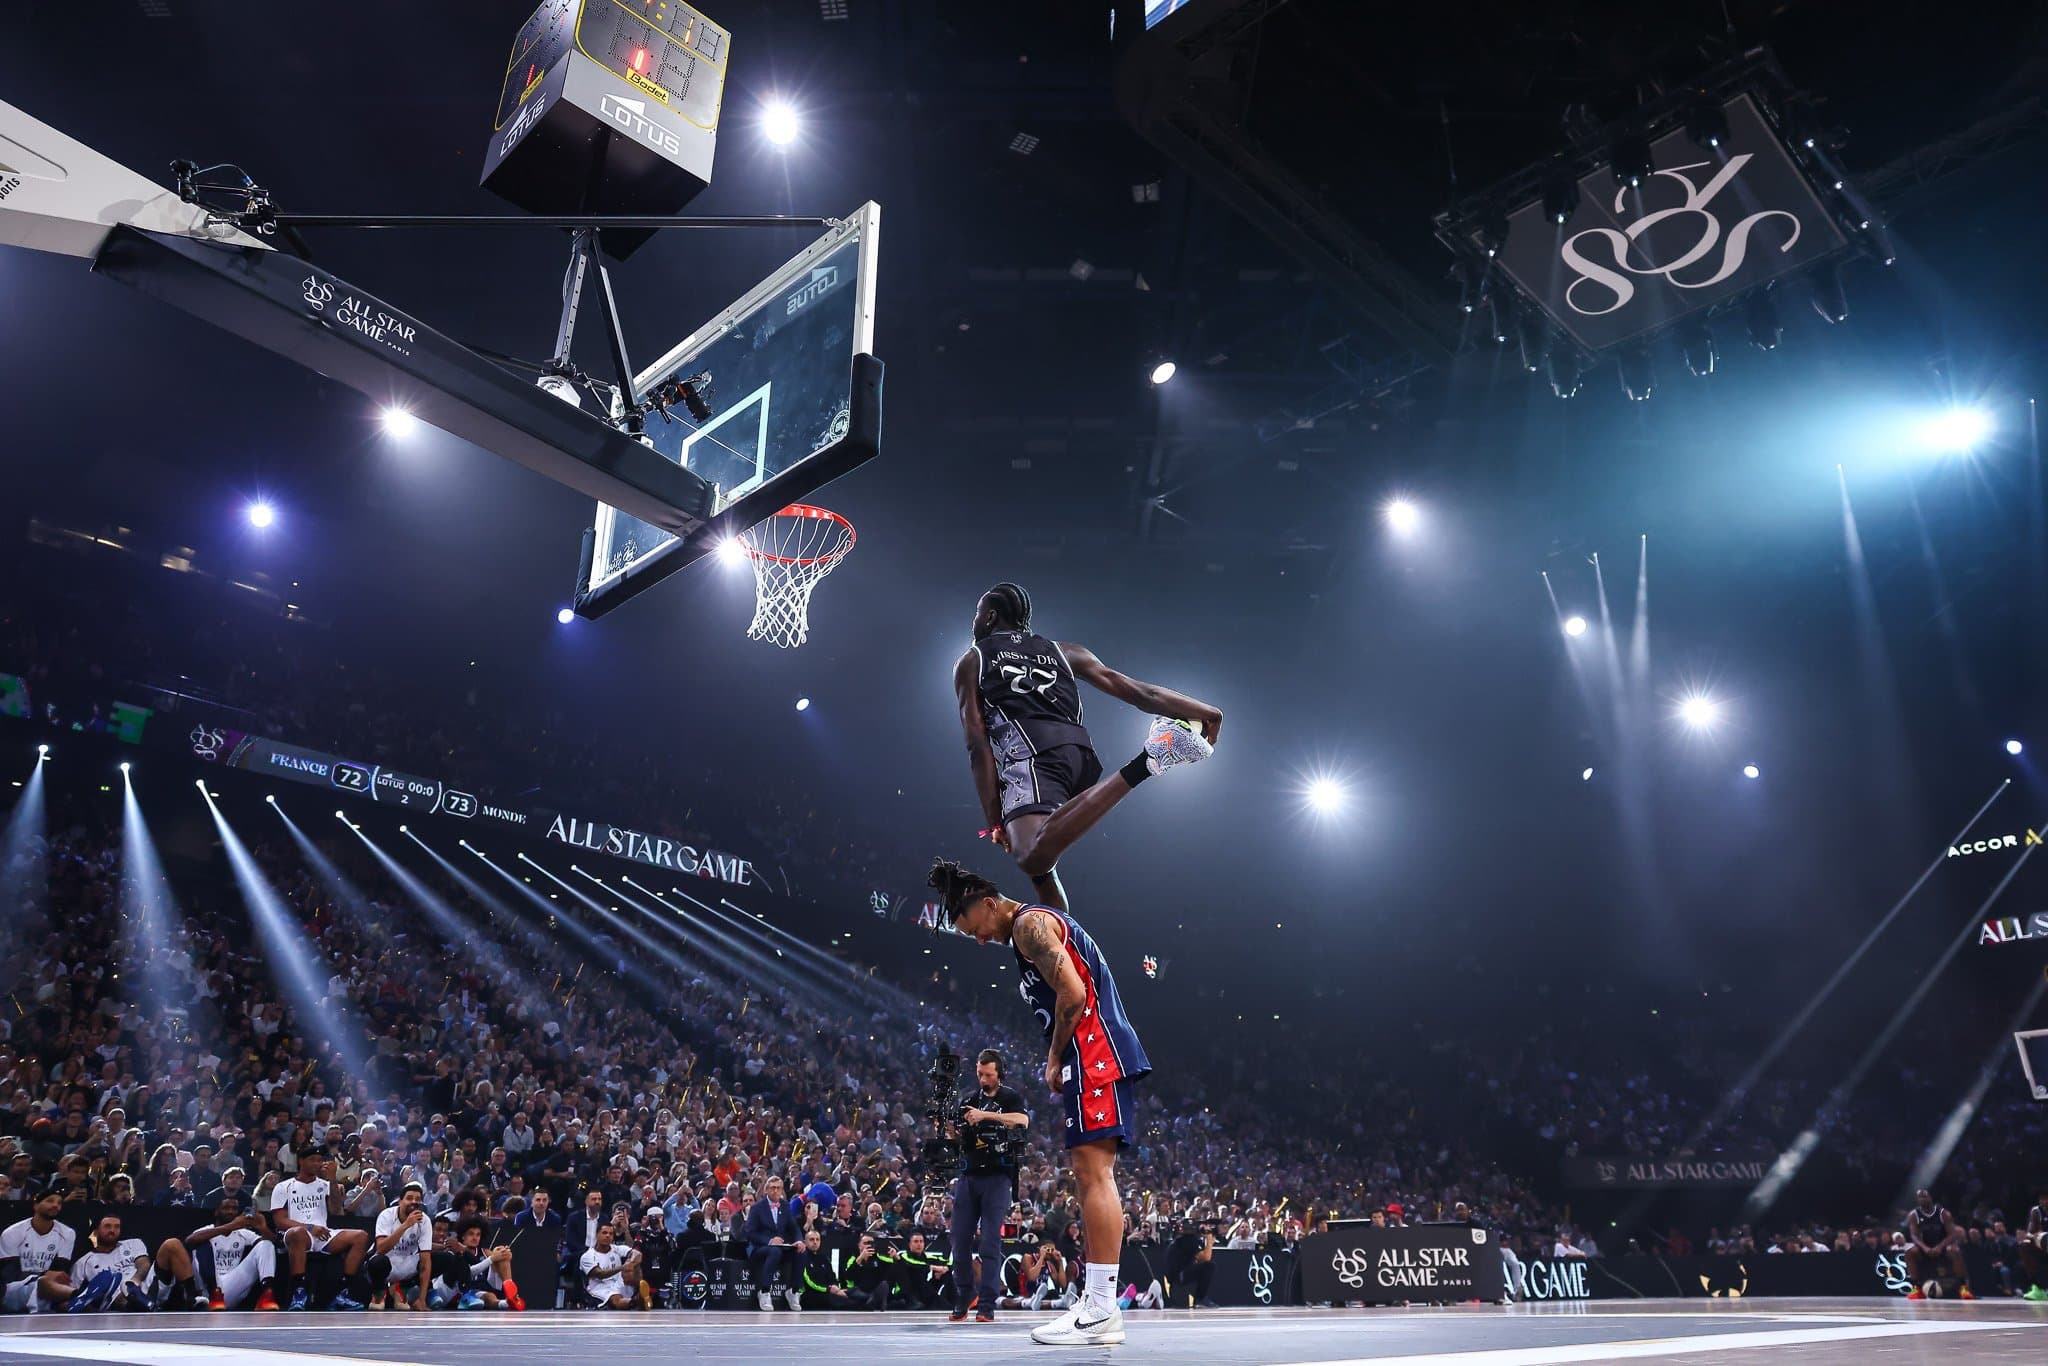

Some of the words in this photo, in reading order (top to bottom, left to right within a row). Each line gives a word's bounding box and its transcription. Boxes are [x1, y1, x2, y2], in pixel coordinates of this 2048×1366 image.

[631, 72, 667, 101] Bodet
[500, 98, 545, 157] LOTUS
[600, 97, 680, 156] LOTUS
[336, 308, 387, 342] GAME
[340, 296, 373, 321] ALL
[375, 312, 416, 343] STAR
[270, 753, 328, 776] FRANCE
[340, 769, 362, 786] 72
[408, 781, 434, 797] 00:0
[401, 795, 409, 804] 2
[450, 796, 469, 812] 73
[482, 805, 526, 825] MONDE
[546, 813, 602, 850] ALL
[606, 827, 673, 867] STAR
[676, 845, 753, 886] GAME
[1947, 834, 2018, 858] ACCOR
[1978, 917, 2033, 945] ALL
[1627, 1163, 1663, 1180] ALL
[1664, 1162, 1711, 1180] STAR
[1378, 1248, 1417, 1267] ALL
[1419, 1248, 1470, 1267] STAR
[1377, 1267, 1438, 1287] GAME
[1531, 1260, 1590, 1298] GAME
